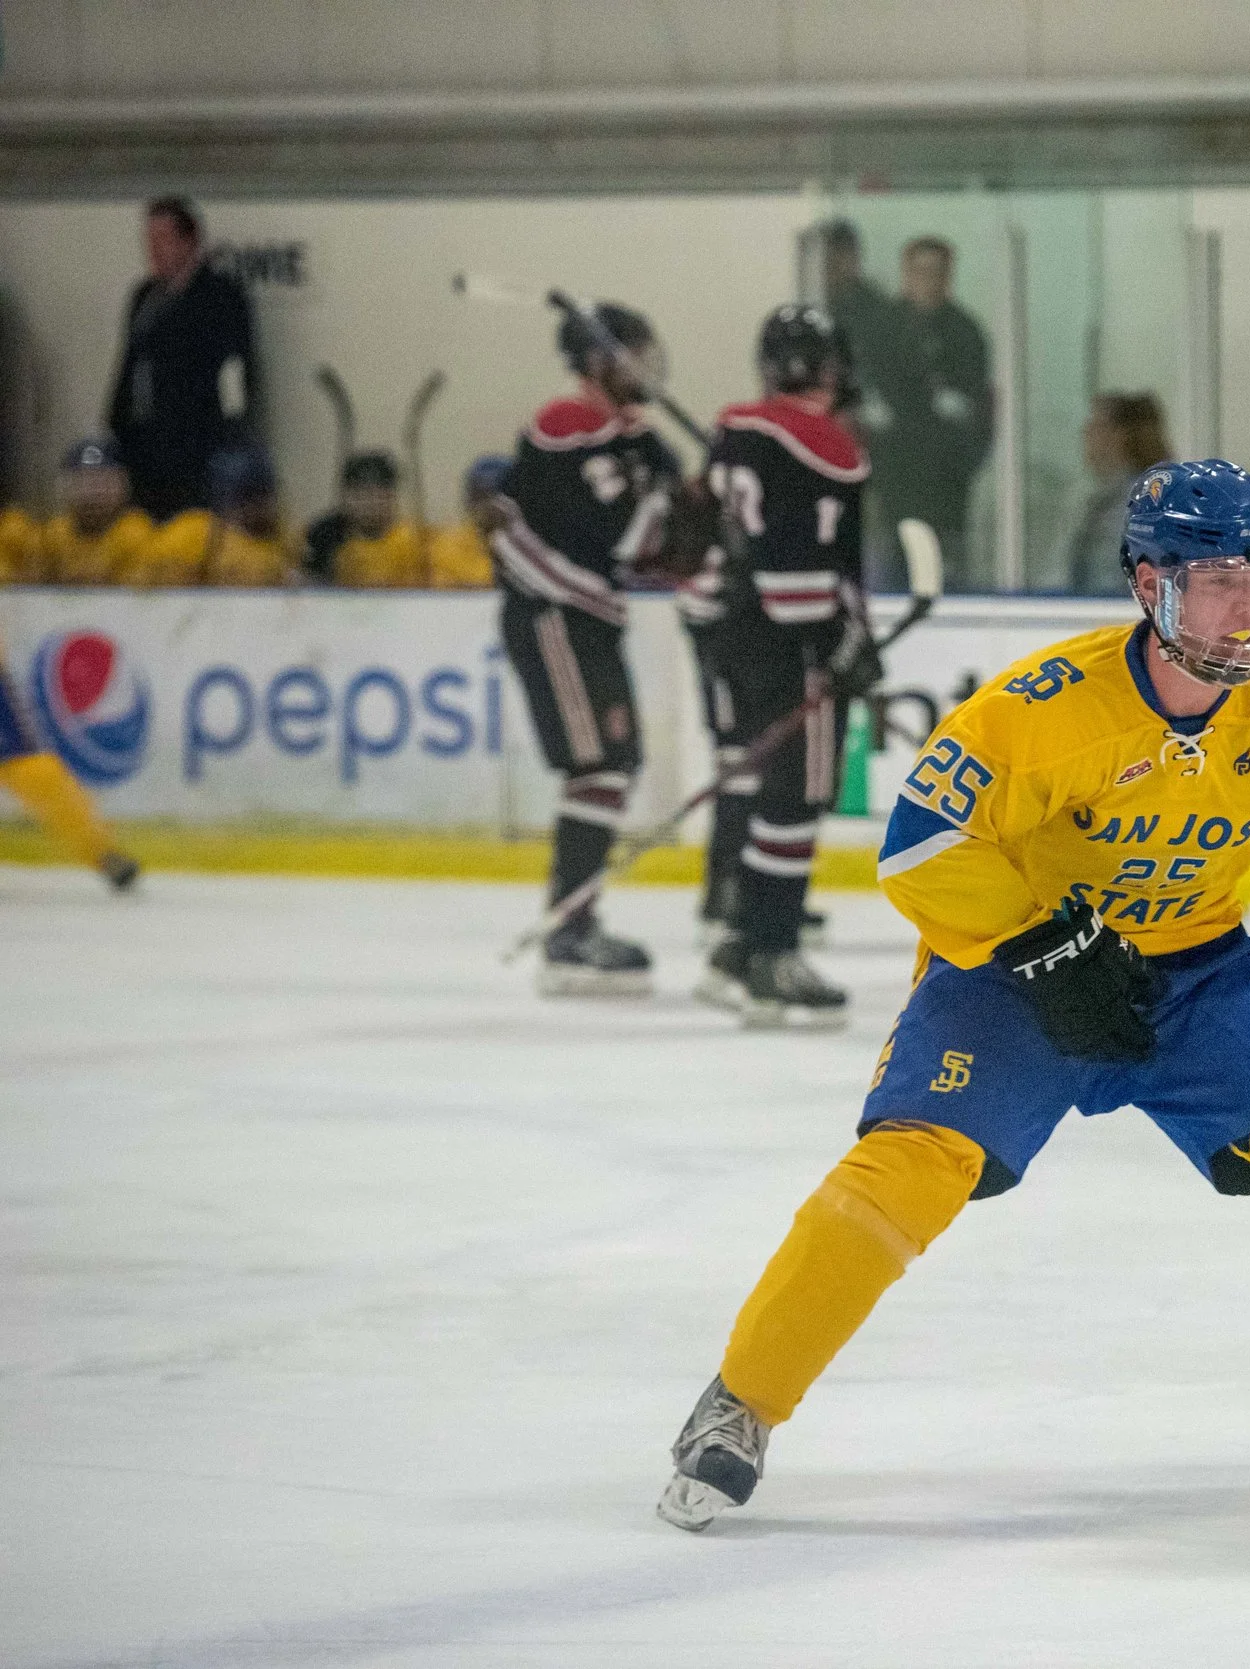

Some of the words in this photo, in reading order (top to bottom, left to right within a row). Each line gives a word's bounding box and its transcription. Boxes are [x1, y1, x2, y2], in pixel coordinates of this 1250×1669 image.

[183, 646, 504, 785] pepsi
[904, 737, 995, 824] 25
[1052, 882, 1206, 925] STATE
[1111, 858, 1208, 888] 25
[1013, 908, 1104, 980] TRU
